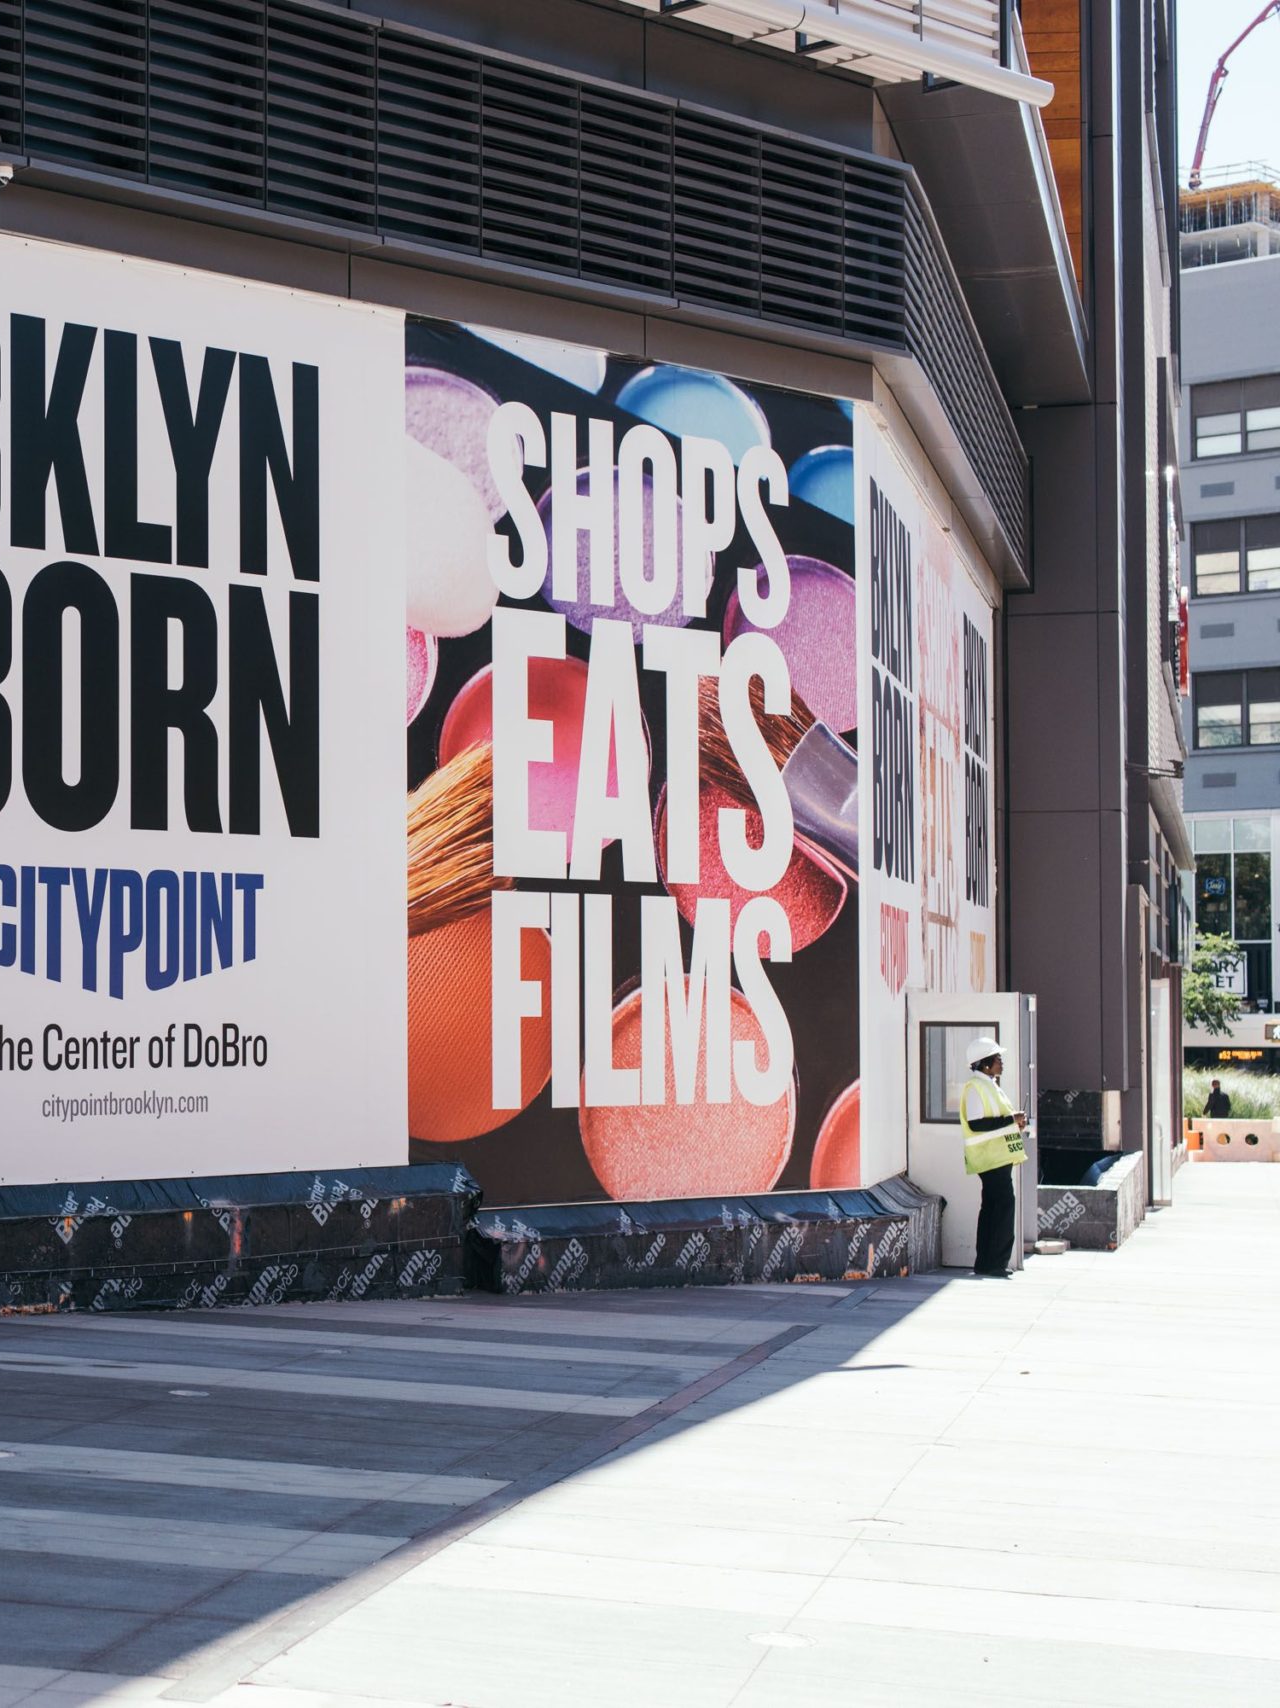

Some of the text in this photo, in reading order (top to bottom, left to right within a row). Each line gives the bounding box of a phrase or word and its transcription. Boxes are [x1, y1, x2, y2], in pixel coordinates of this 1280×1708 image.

[487, 401, 791, 629] SHOPS
[870, 475, 912, 693] BKLYN
[492, 606, 794, 892] EATS
[872, 665, 914, 884] BORN
[965, 751, 989, 909] BORN
[42, 1090, 208, 1122] citypointbrooklyn.com
[43, 1023, 140, 1071] Center
[148, 1023, 176, 1068] of
[184, 1023, 268, 1068] DoBro
[492, 890, 794, 1110] FILMS
